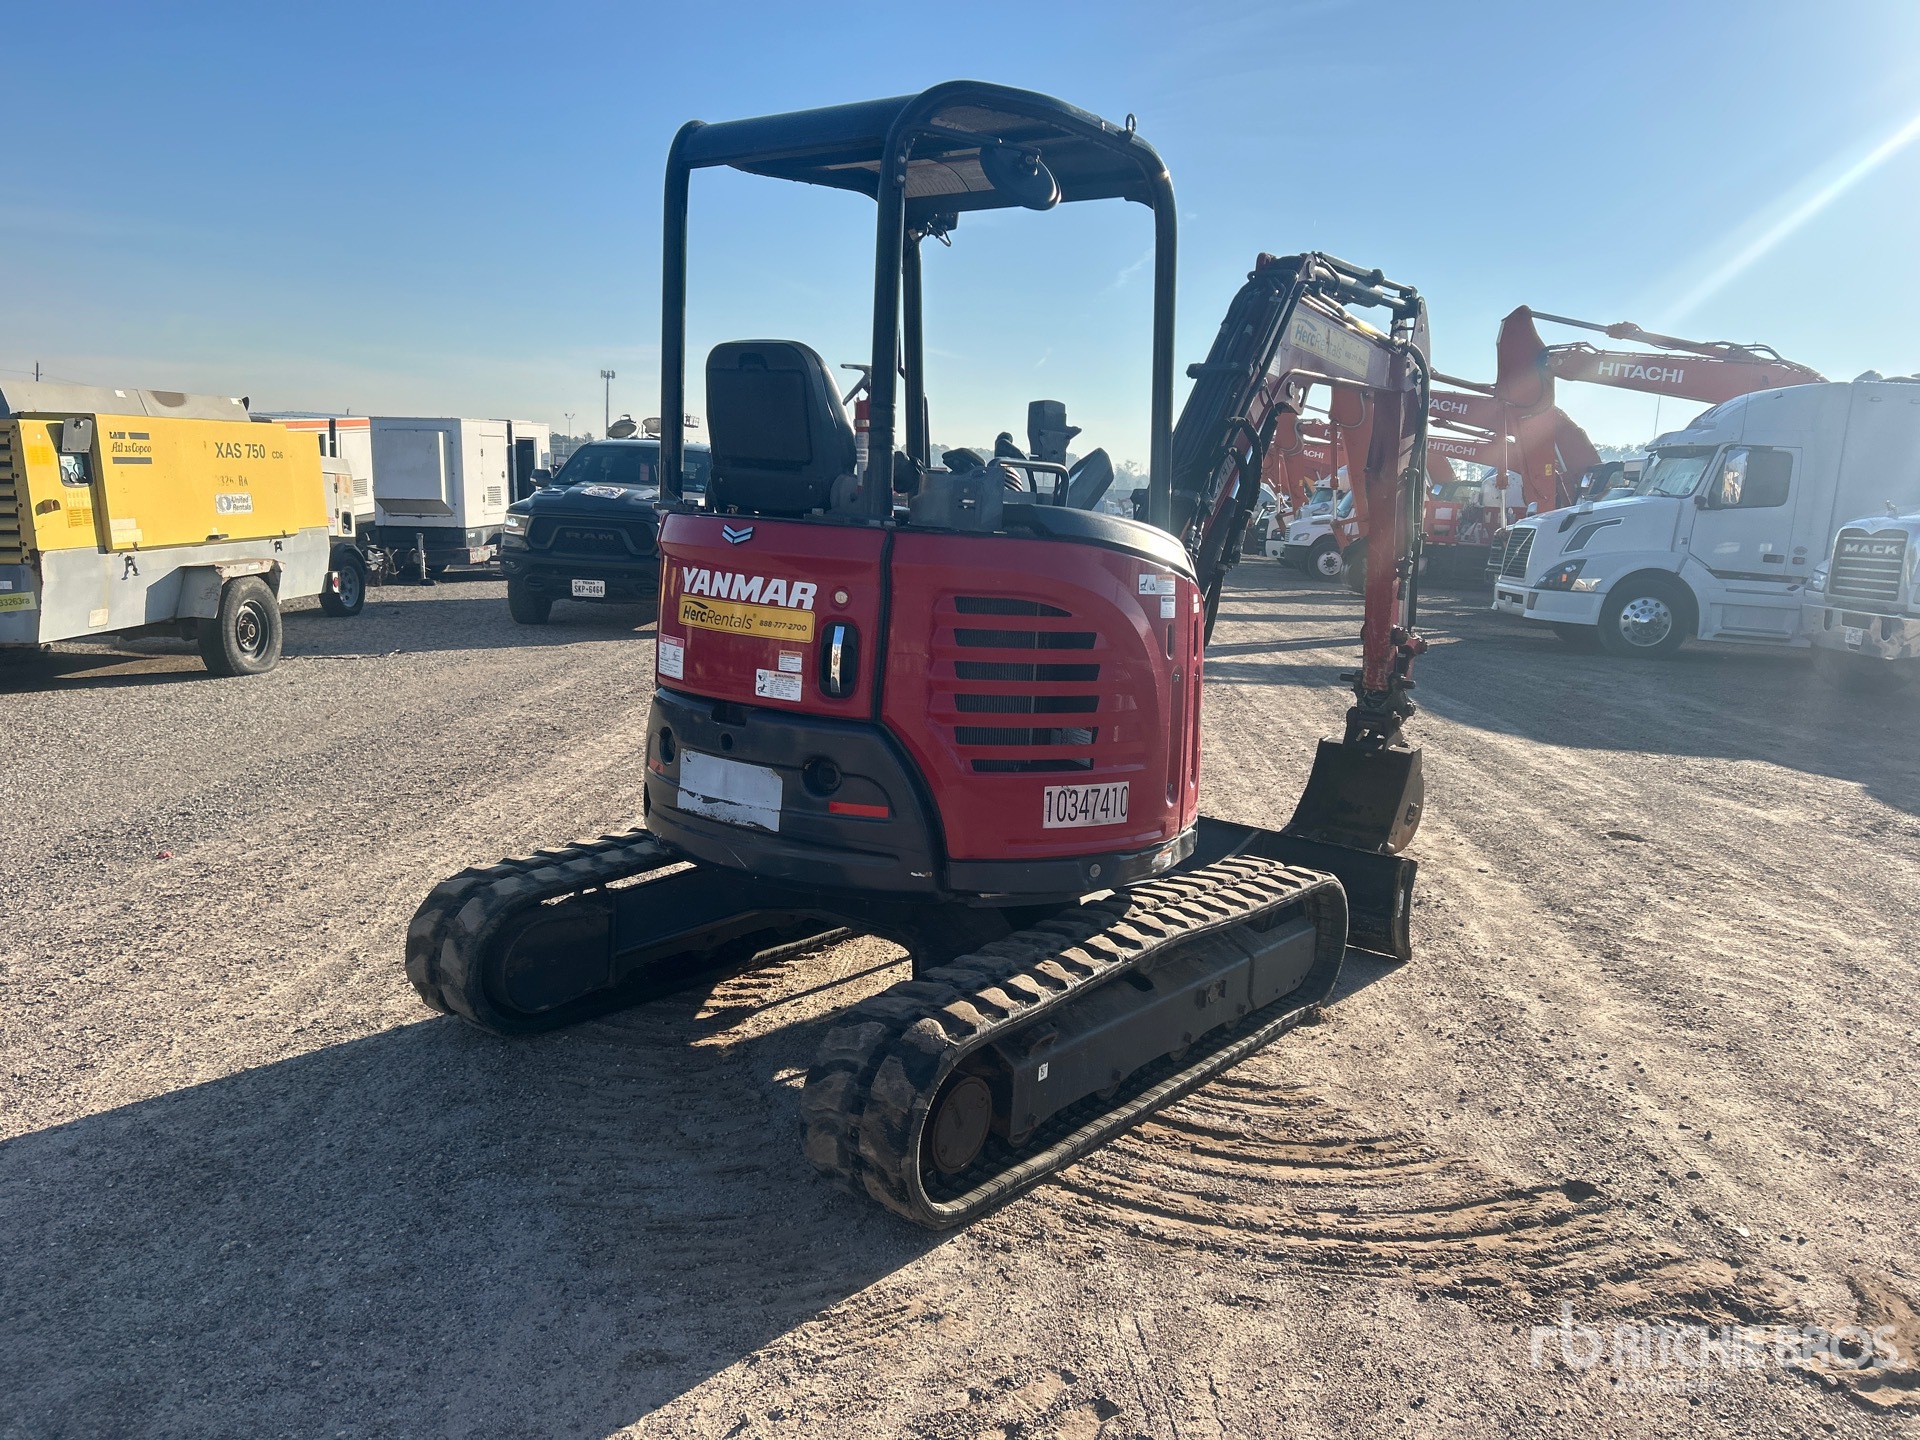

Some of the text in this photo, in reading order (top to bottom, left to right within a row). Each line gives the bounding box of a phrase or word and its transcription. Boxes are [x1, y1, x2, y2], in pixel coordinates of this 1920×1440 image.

[1597, 361, 1685, 384] HITACHI
[132, 442, 152, 455] Copco
[214, 442, 242, 458] XAS
[245, 443, 266, 459] 750
[1427, 440, 1476, 457] HITACHI
[231, 496, 249, 504] United
[233, 503, 252, 511] Rentals
[565, 531, 614, 540] RAM
[1844, 543, 1899, 555] MACK
[682, 566, 818, 611] YANMAR
[759, 619, 808, 632] 888-777-2700
[1046, 785, 1129, 823] 10347410
